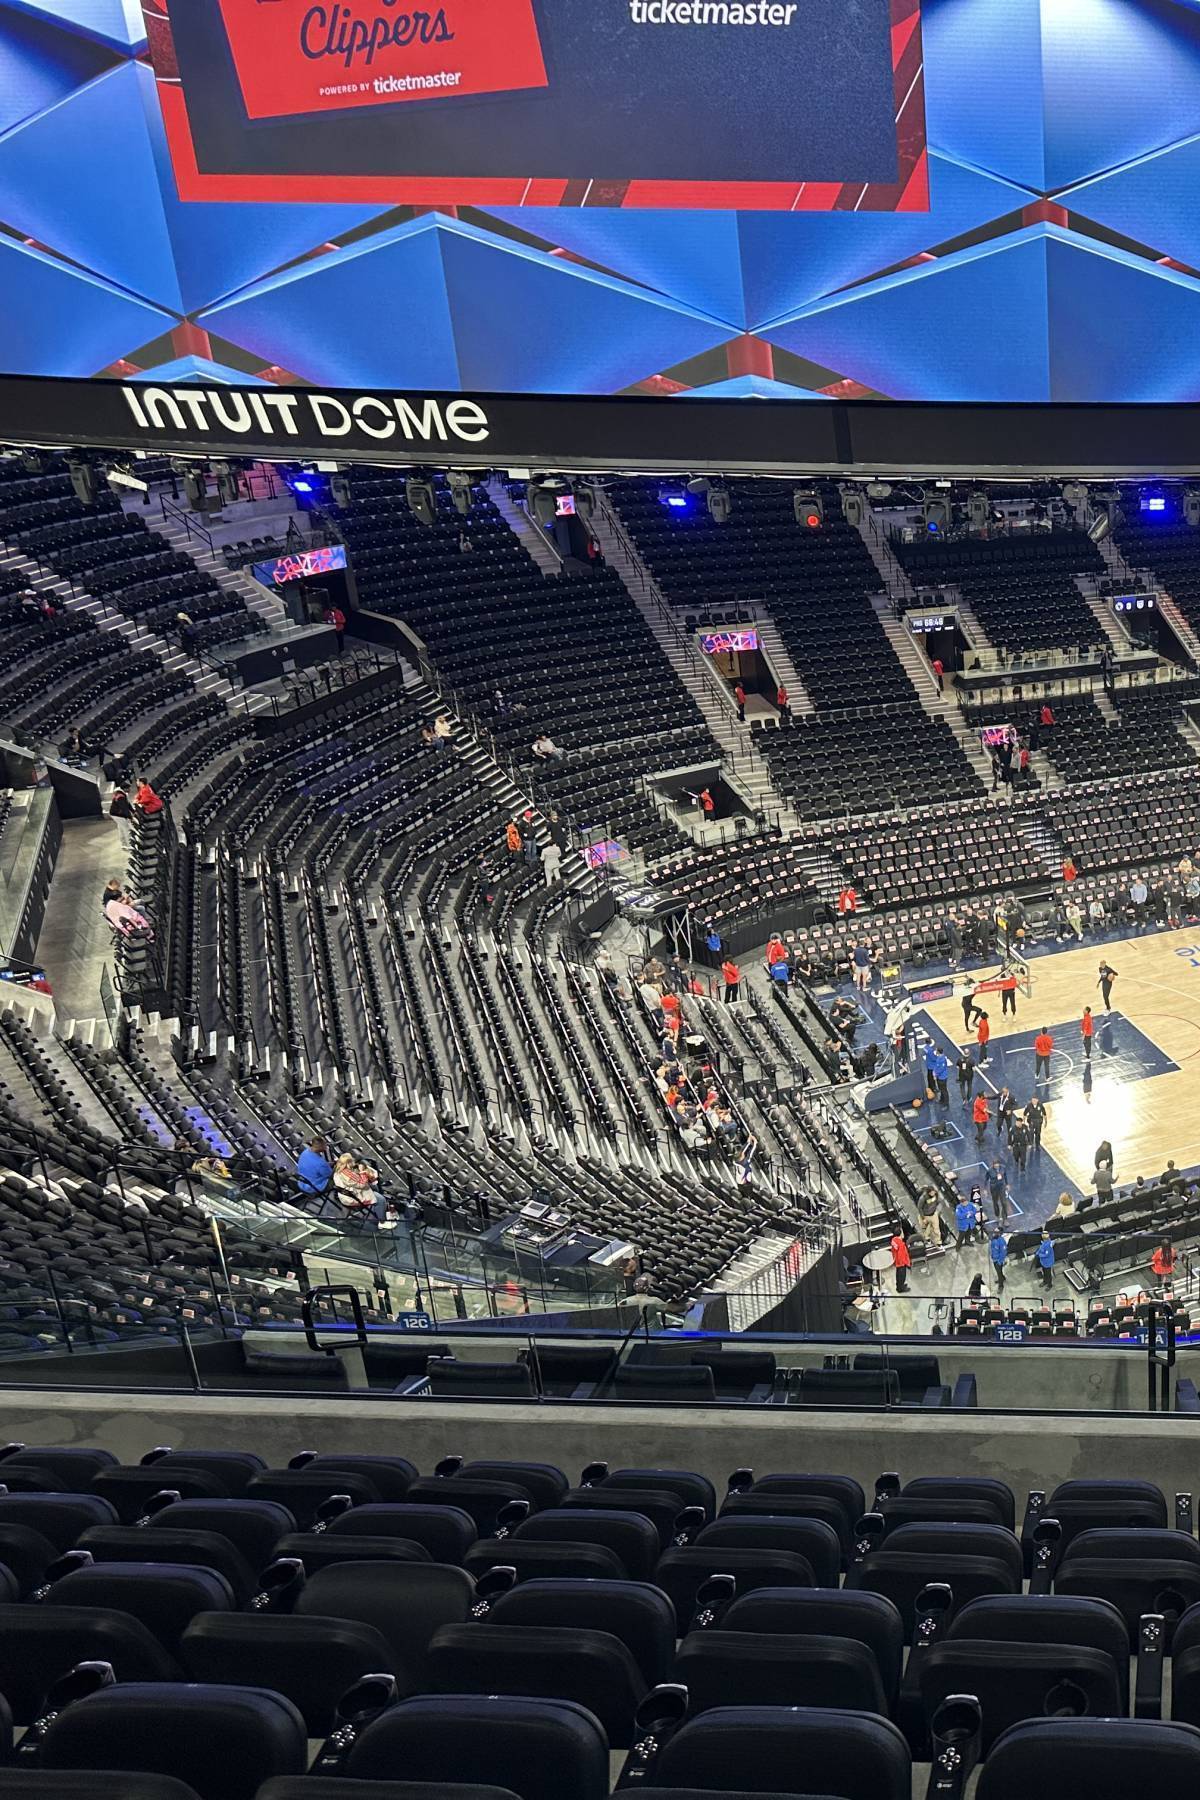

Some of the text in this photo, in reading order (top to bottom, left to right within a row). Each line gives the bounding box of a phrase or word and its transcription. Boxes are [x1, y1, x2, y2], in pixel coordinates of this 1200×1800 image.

[629, 0, 797, 26] ticketmaster
[300, 4, 455, 67] Clippers
[319, 70, 462, 96] POWERED BY ticketmaster
[122, 387, 299, 435] INTUIT
[403, 1318, 429, 1328] 12C
[998, 1330, 1022, 1340] 12B
